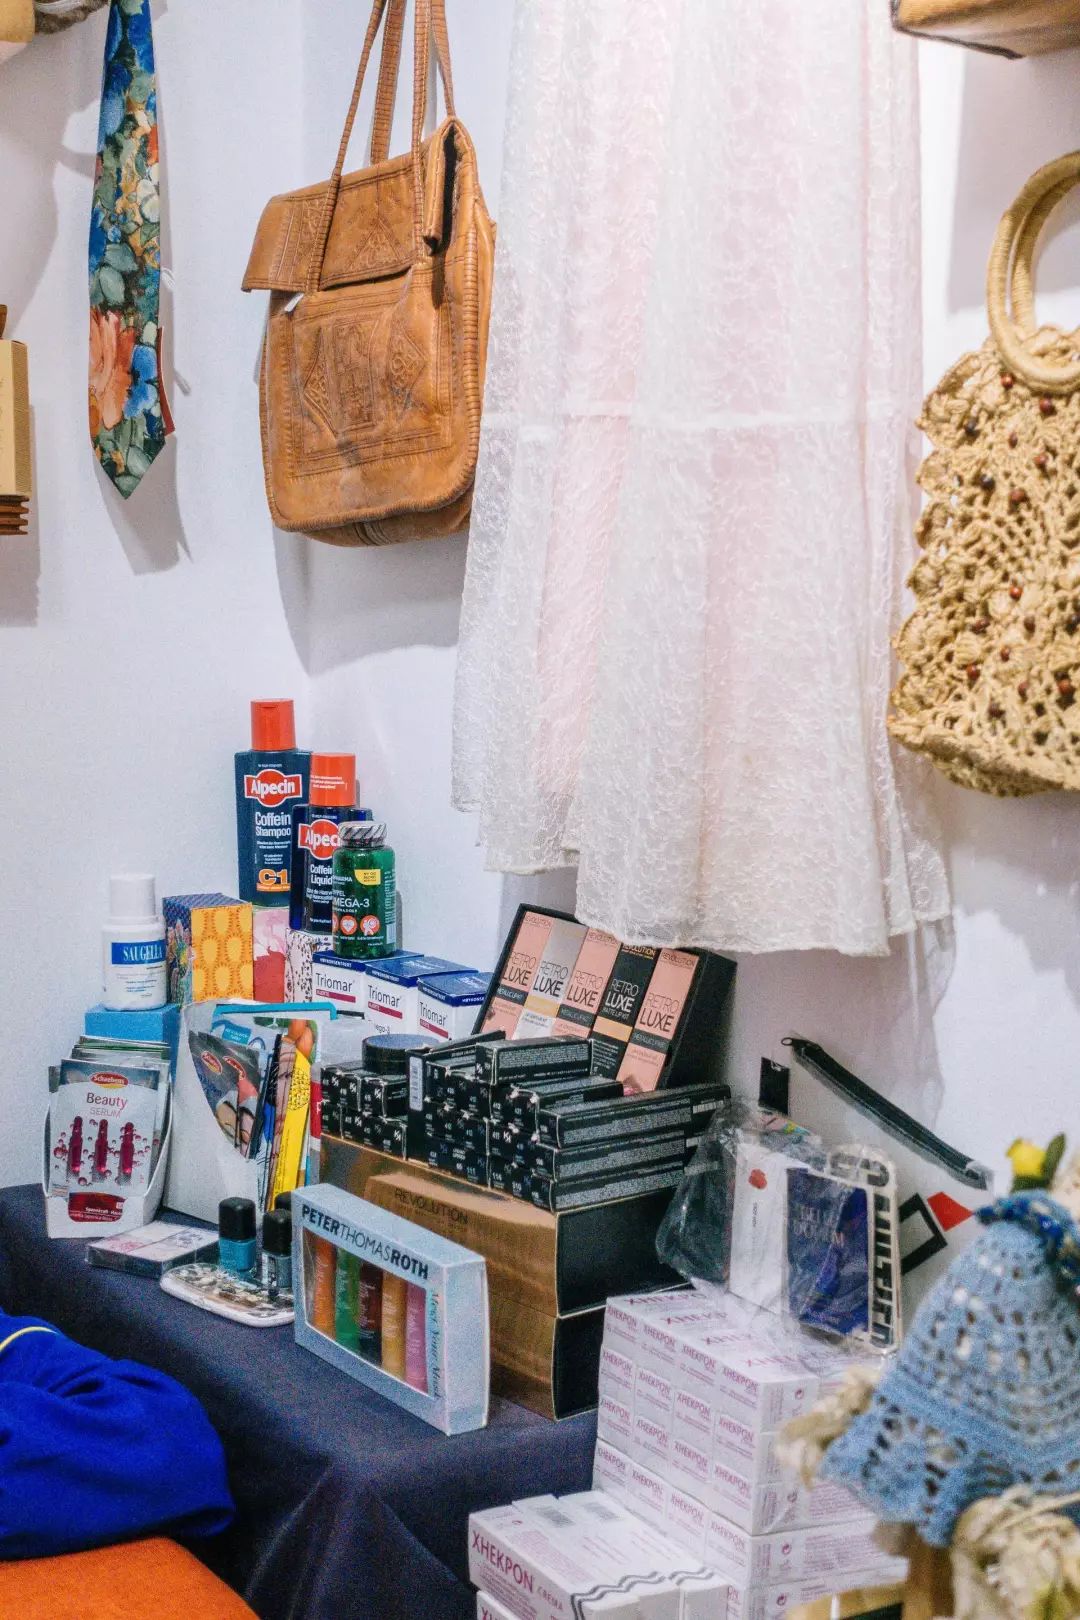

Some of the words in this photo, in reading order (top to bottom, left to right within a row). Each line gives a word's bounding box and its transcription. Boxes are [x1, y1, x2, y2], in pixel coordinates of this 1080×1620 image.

[251, 779, 296, 799] Alpecin
[254, 811, 292, 826] Coffein
[255, 827, 292, 839] Shampoo
[304, 829, 341, 850] Alpeci
[258, 868, 288, 886] C1
[310, 875, 333, 887] Liquid
[333, 897, 370, 908] MEGA-3
[123, 944, 163, 961] SAUGELLA
[508, 951, 537, 970] RETRO
[502, 963, 532, 987] LUXE
[538, 961, 569, 979] RETRO
[573, 970, 604, 990] RETRO
[315, 973, 353, 993] Triomar
[532, 974, 564, 998] LUXE
[611, 978, 639, 996] RETRO
[368, 985, 400, 1008] Triomar
[566, 983, 599, 1008] LUXE
[604, 992, 635, 1013] LUXE
[646, 992, 680, 1014] RETRO
[420, 1001, 447, 1027] Triomar
[639, 1007, 675, 1032] LUXE
[86, 1092, 128, 1111] Beauty
[90, 1106, 121, 1119] SERUM
[394, 1188, 468, 1225] REVOLUTION
[607, 1304, 637, 1328] XHEKPON
[643, 1323, 676, 1348] XHEKPON
[602, 1350, 633, 1373] XHEKPON
[682, 1343, 716, 1369] XHEKPON
[639, 1370, 672, 1395] XHEKPON
[722, 1366, 759, 1392] XHEKPON
[600, 1399, 630, 1421] XHEKPON
[677, 1391, 711, 1415] XHEKPON
[637, 1419, 668, 1444] XHEKPON
[719, 1415, 754, 1443] XHEKPON
[674, 1440, 708, 1467] XHEKPON
[632, 1469, 664, 1495] XHEKPON
[714, 1464, 751, 1492] XHEKPON
[671, 1492, 704, 1520] XHEKPON
[472, 1529, 535, 1593] XHEKPON
